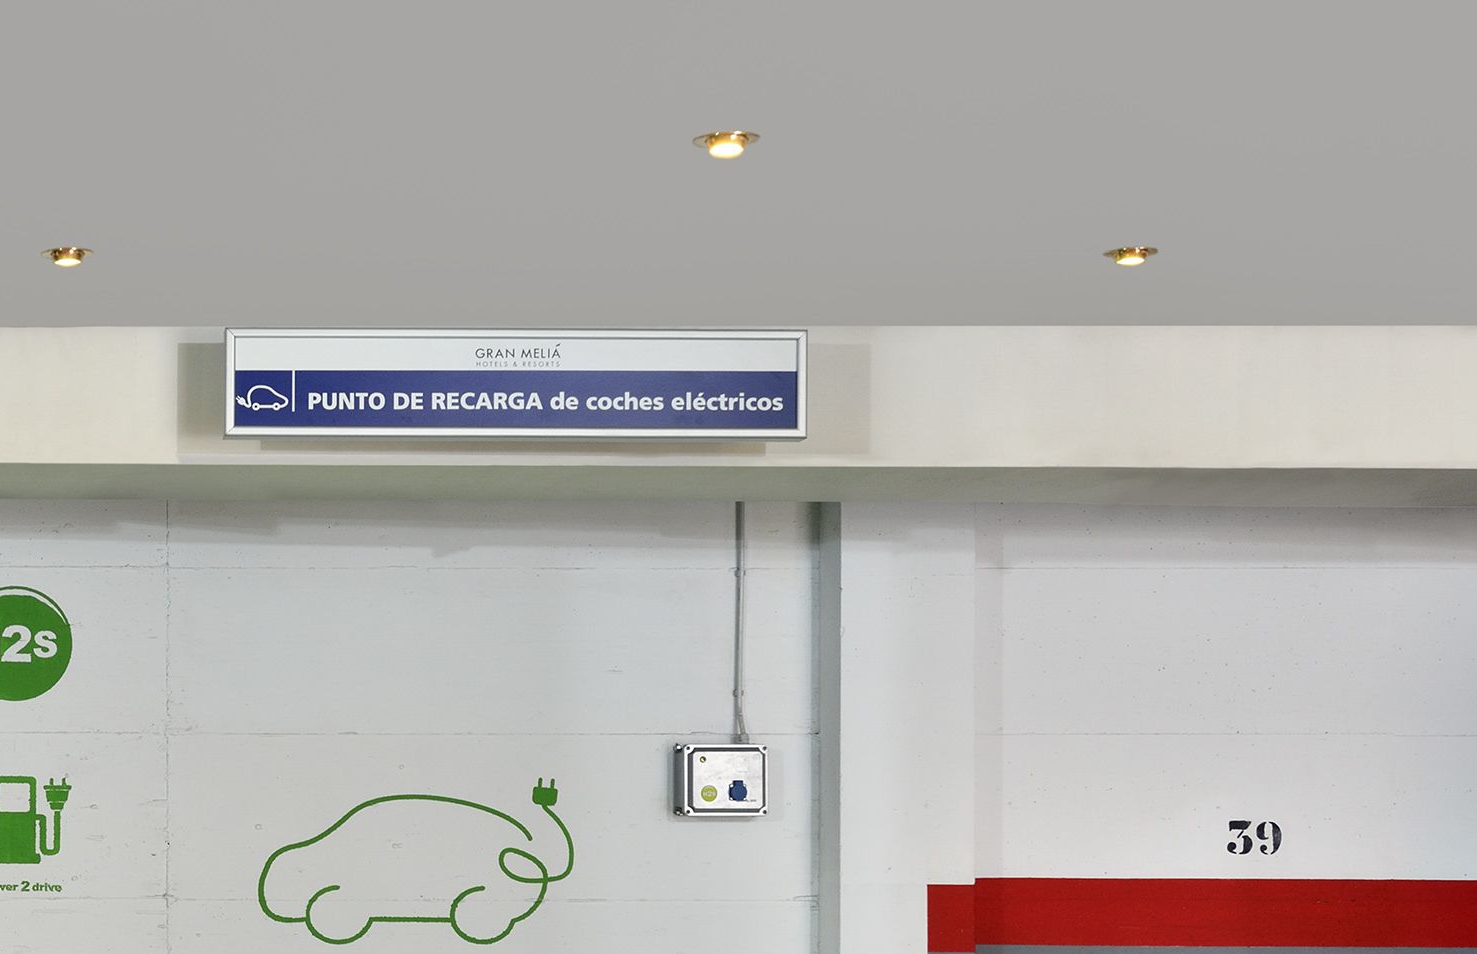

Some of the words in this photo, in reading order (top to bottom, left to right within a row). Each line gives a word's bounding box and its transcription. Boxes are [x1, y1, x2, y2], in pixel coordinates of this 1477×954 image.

[476, 348, 516, 359] GRAN
[521, 343, 561, 359] MELIÁ
[308, 392, 385, 410] PUNTO
[393, 392, 424, 410] DE
[432, 392, 543, 410] RECARGA
[550, 392, 579, 410] de
[586, 392, 664, 411] coches
[671, 392, 784, 412] eléctricos
[1226, 820, 1282, 855] 39
[21, 881, 30, 892] 2
[32, 882, 62, 893] drive
